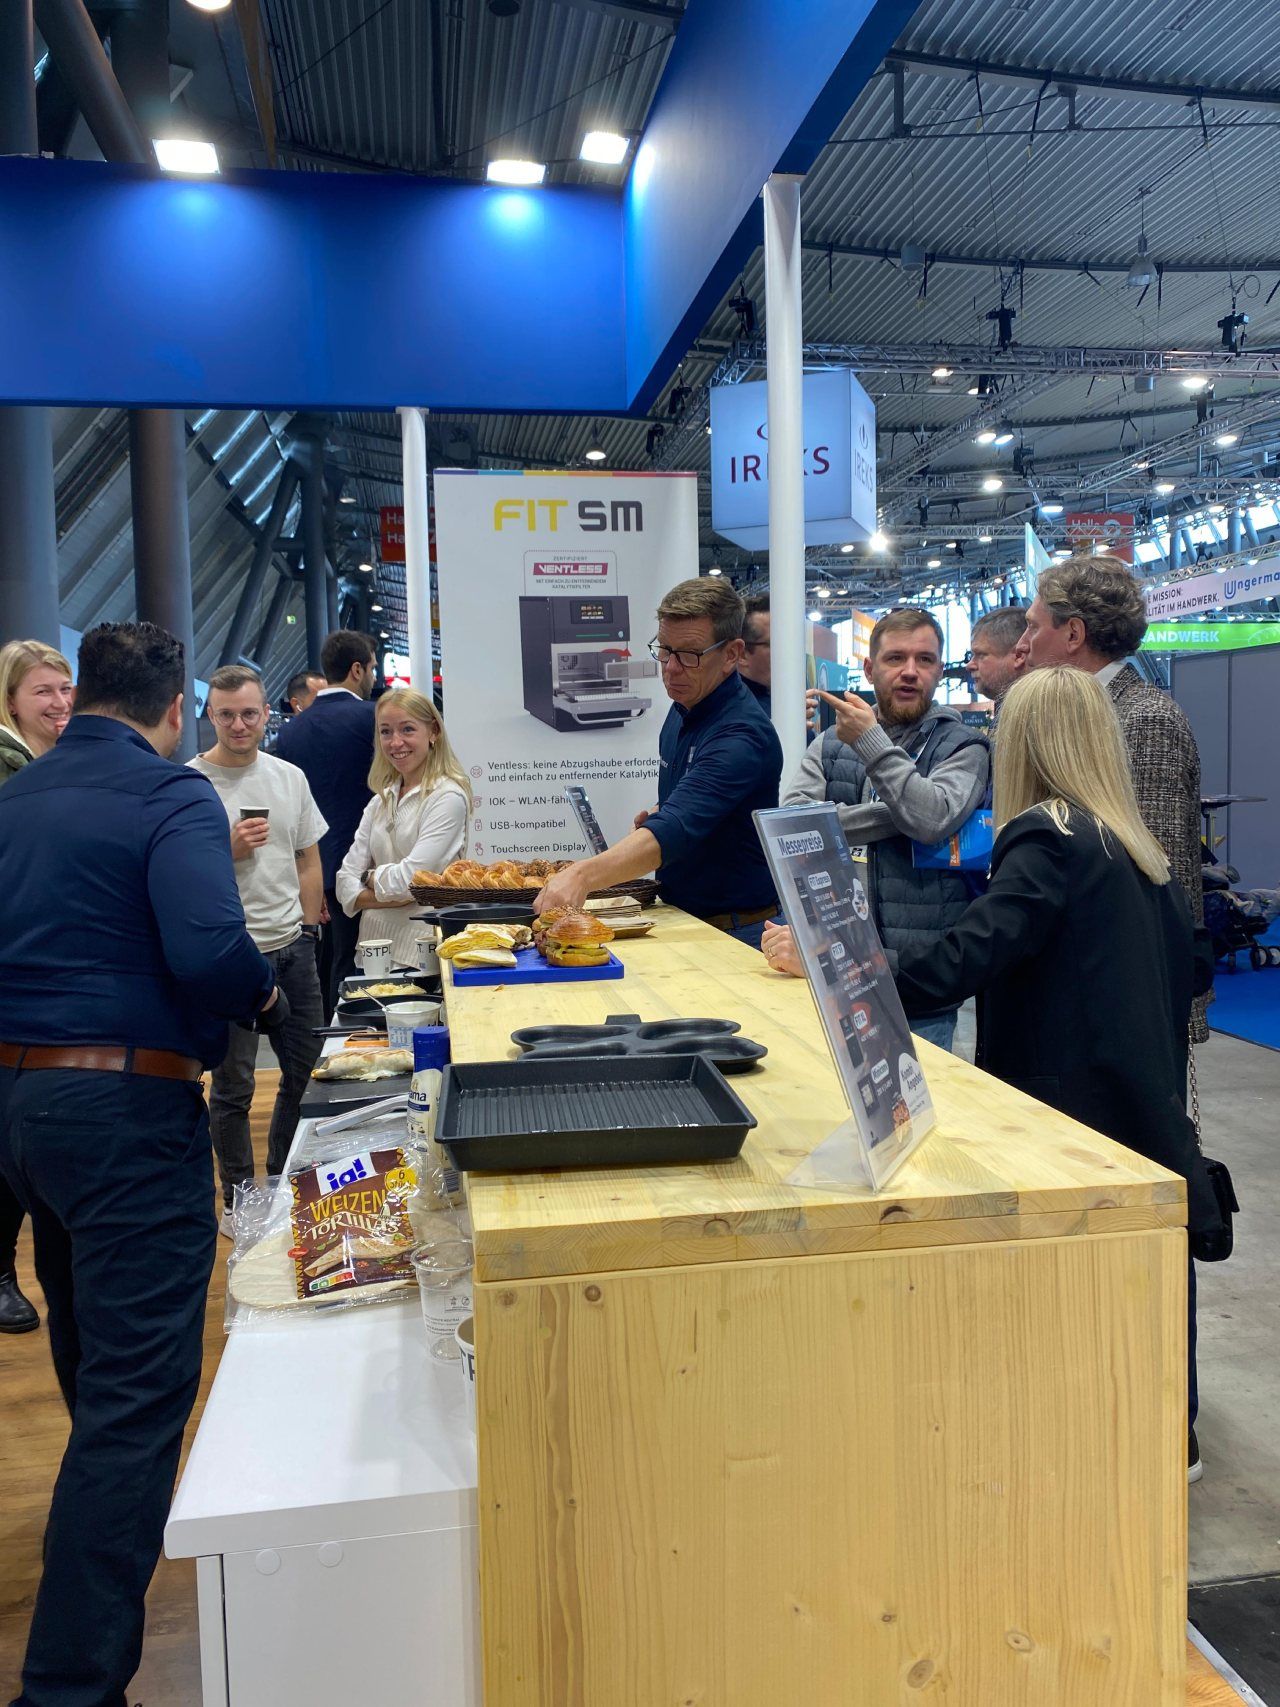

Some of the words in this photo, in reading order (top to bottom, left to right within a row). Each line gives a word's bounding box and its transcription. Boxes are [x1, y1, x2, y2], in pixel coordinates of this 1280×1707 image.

[731, 446, 830, 483] IRS
[854, 448, 874, 492] IREKS
[494, 499, 568, 532] FIT
[578, 500, 643, 532] SM
[538, 564, 603, 574] VENTLESS
[1224, 572, 1280, 600] Ungerma
[1146, 603, 1165, 617] LITÄT
[1167, 601, 1176, 611] IM
[1177, 592, 1220, 610] HANDWERK.
[1143, 630, 1220, 643] ANDWERK
[488, 761, 531, 770] Ventless:
[533, 760, 558, 769] keine
[560, 757, 622, 770] Abzugshaube
[624, 757, 660, 767] erforder
[488, 773, 506, 782] und
[508, 772, 543, 782] einfach
[545, 773, 557, 781] zu
[559, 770, 617, 780] entfernender
[619, 769, 659, 779] Katalytik
[490, 819, 566, 830] USB-kompatibel
[491, 843, 550, 854] Touchscreen
[552, 842, 587, 853] Display
[777, 833, 823, 857] Messepreise
[398, 1170, 405, 1180] 6
[309, 1189, 386, 1222] WEIZEN
[302, 1211, 402, 1240] TORTILLAS
